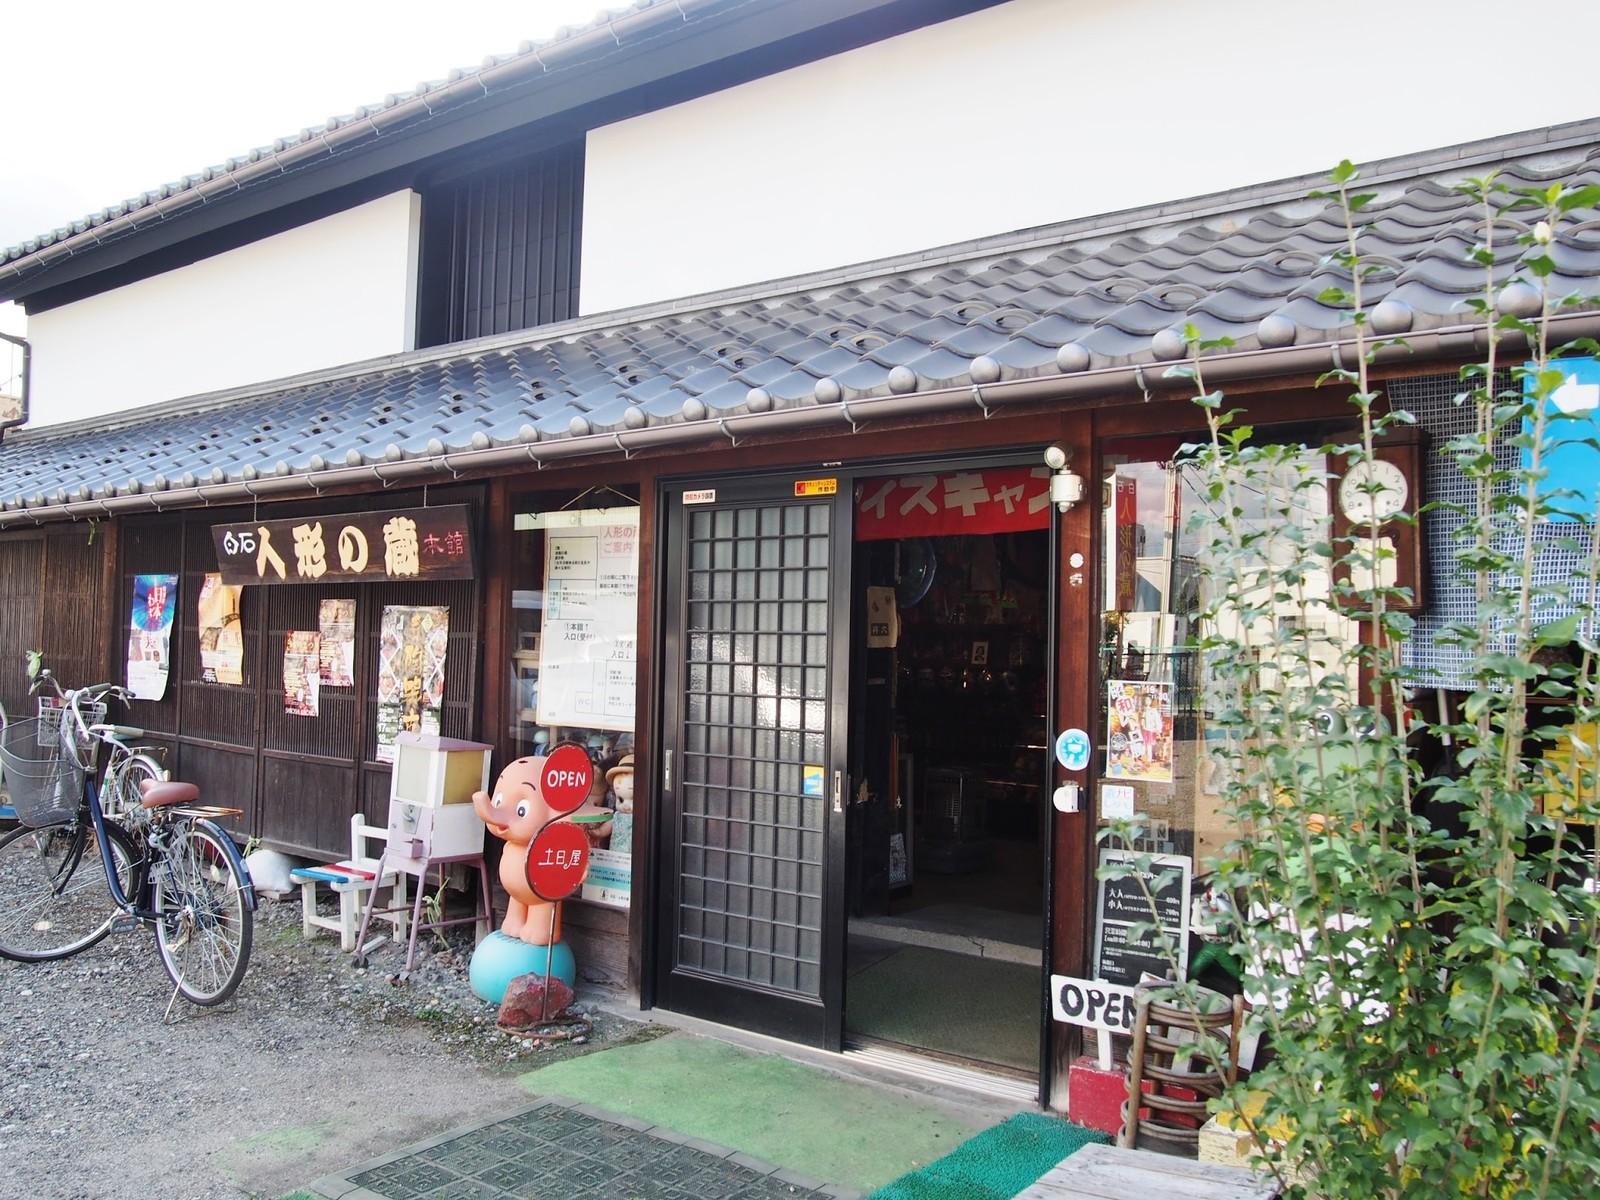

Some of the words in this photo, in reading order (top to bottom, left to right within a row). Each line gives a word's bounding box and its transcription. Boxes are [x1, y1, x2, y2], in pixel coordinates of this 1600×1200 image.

[856, 467, 1050, 519] イスキャン
[256, 516, 419, 579] 人形の蔵
[422, 531, 464, 555] 本館
[547, 770, 586, 788] OPEN
[538, 848, 581, 870] 土日屋
[1108, 888, 1124, 899] 大人
